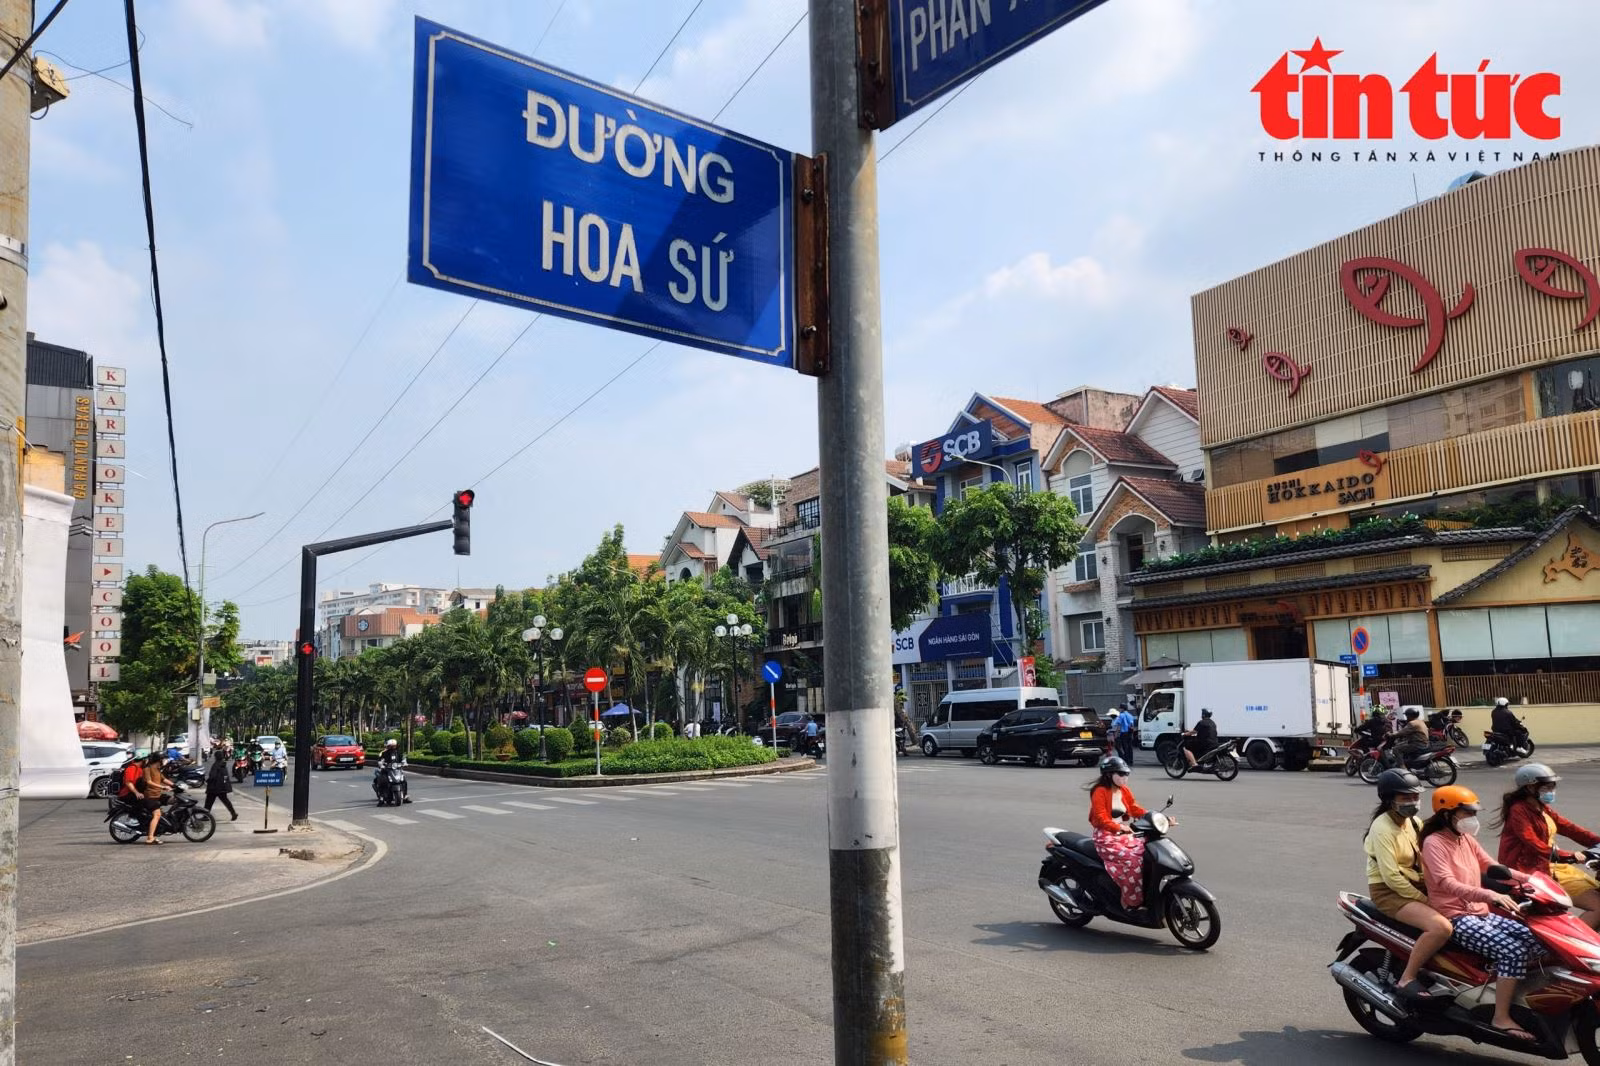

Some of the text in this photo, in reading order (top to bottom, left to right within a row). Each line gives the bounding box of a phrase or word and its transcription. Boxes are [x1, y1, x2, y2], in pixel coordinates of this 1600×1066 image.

[522, 89, 735, 204] ĐƯỜNG
[541, 199, 735, 312] HOA SỨ
[75, 395, 91, 437] TEXAS
[104, 371, 117, 528] KARAOKE
[943, 430, 981, 462] SCB
[1267, 478, 1301, 492] SUSHI
[1267, 472, 1375, 504] HOKKAIDO
[1338, 486, 1375, 505] SACHI
[895, 637, 915, 651] SCB
